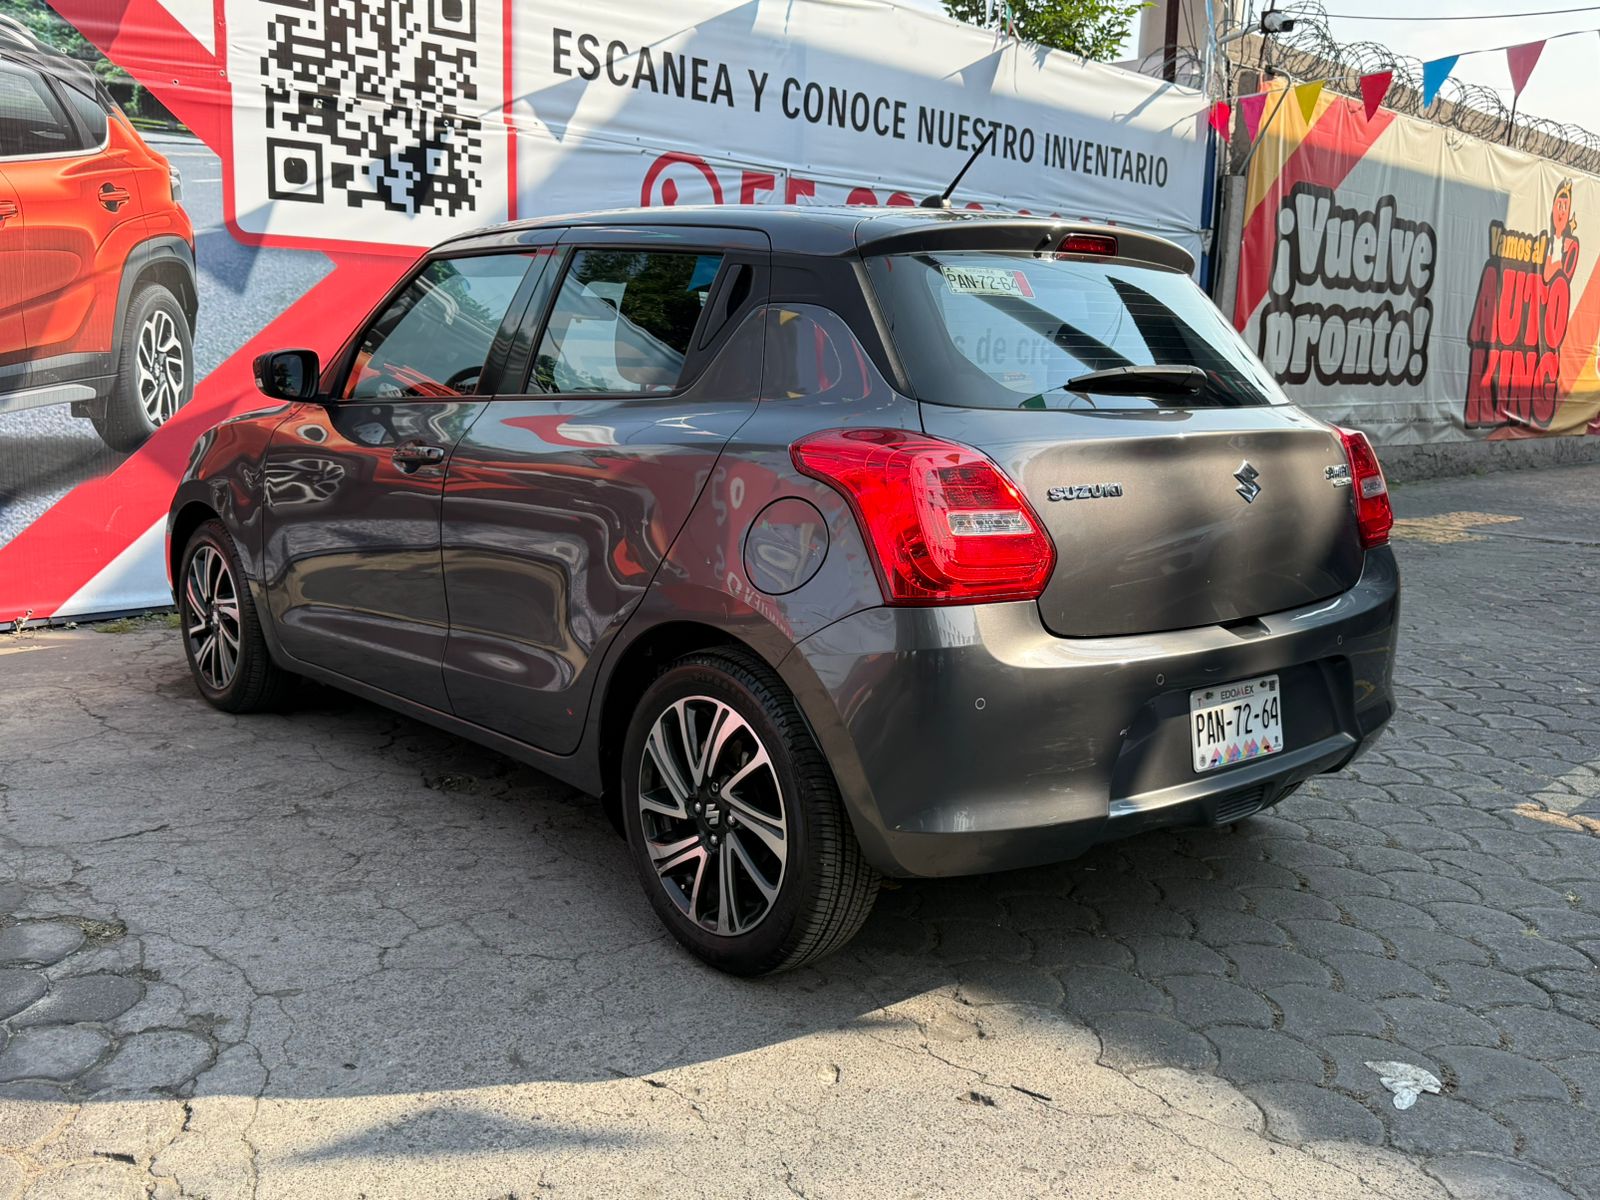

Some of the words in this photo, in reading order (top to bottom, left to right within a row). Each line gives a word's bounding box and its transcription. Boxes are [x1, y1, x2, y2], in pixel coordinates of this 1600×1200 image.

[552, 27, 734, 107] ESCANEA
[748, 68, 769, 112] Y
[781, 77, 907, 139] CONOCE
[917, 105, 1035, 163] NUESTRO
[1044, 132, 1168, 188] INVENTARIO
[1271, 189, 1434, 297] ¡Vuelve
[1490, 225, 1532, 262] Vamos
[1532, 235, 1547, 265] al
[1262, 303, 1432, 381] pronto!
[1469, 264, 1570, 349] AUTO
[976, 328, 1006, 365] de
[1466, 349, 1560, 426] KING
[1046, 481, 1123, 501] SUZUKI
[1195, 696, 1279, 748] PAN-72-64
